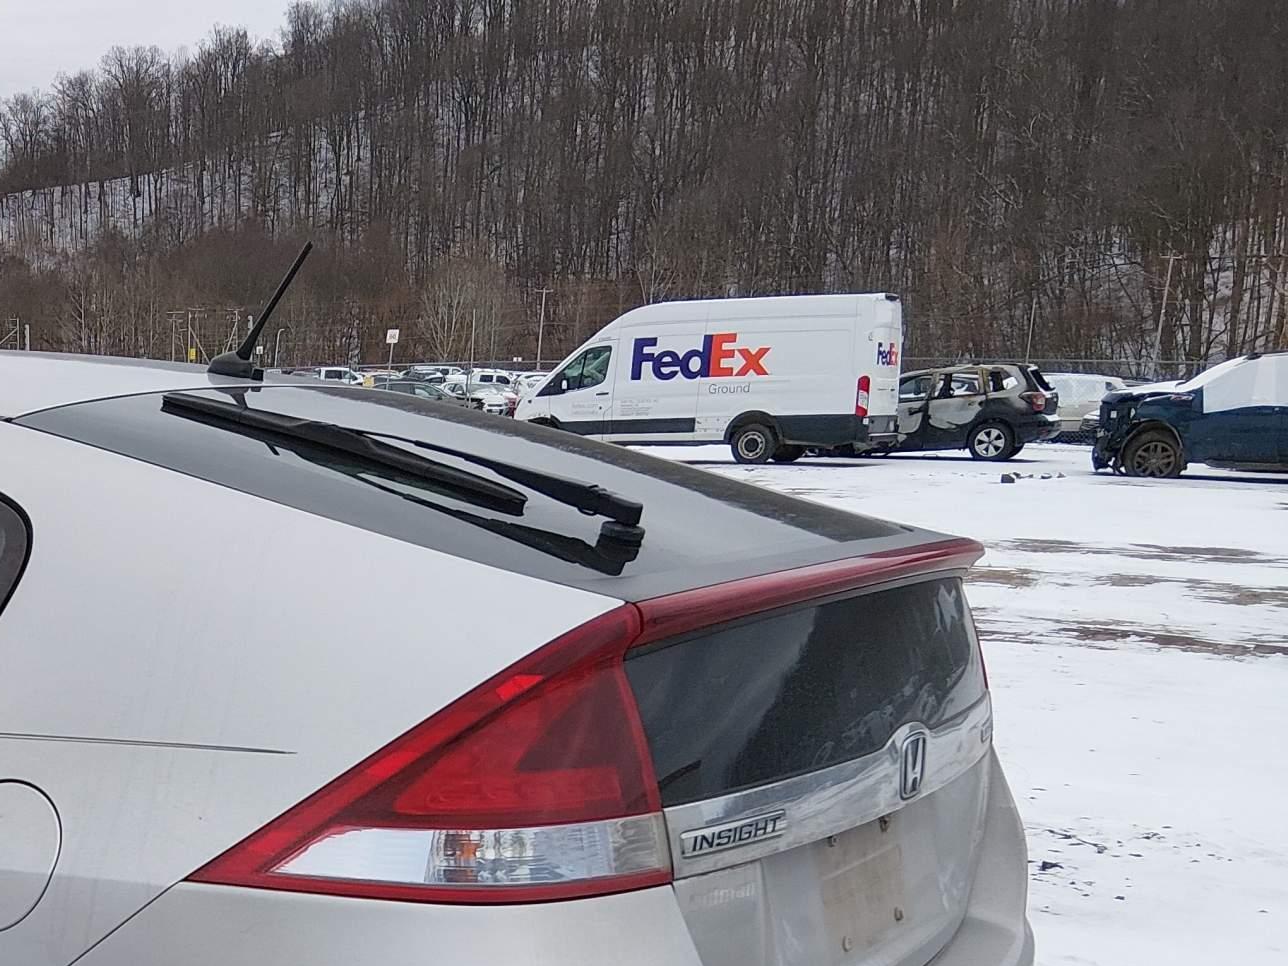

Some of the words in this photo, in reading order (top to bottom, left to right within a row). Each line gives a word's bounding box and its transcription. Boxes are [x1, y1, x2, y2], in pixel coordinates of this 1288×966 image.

[631, 333, 771, 381] FedEx
[708, 383, 751, 395] Ground
[692, 816, 782, 852] INSIGHT
